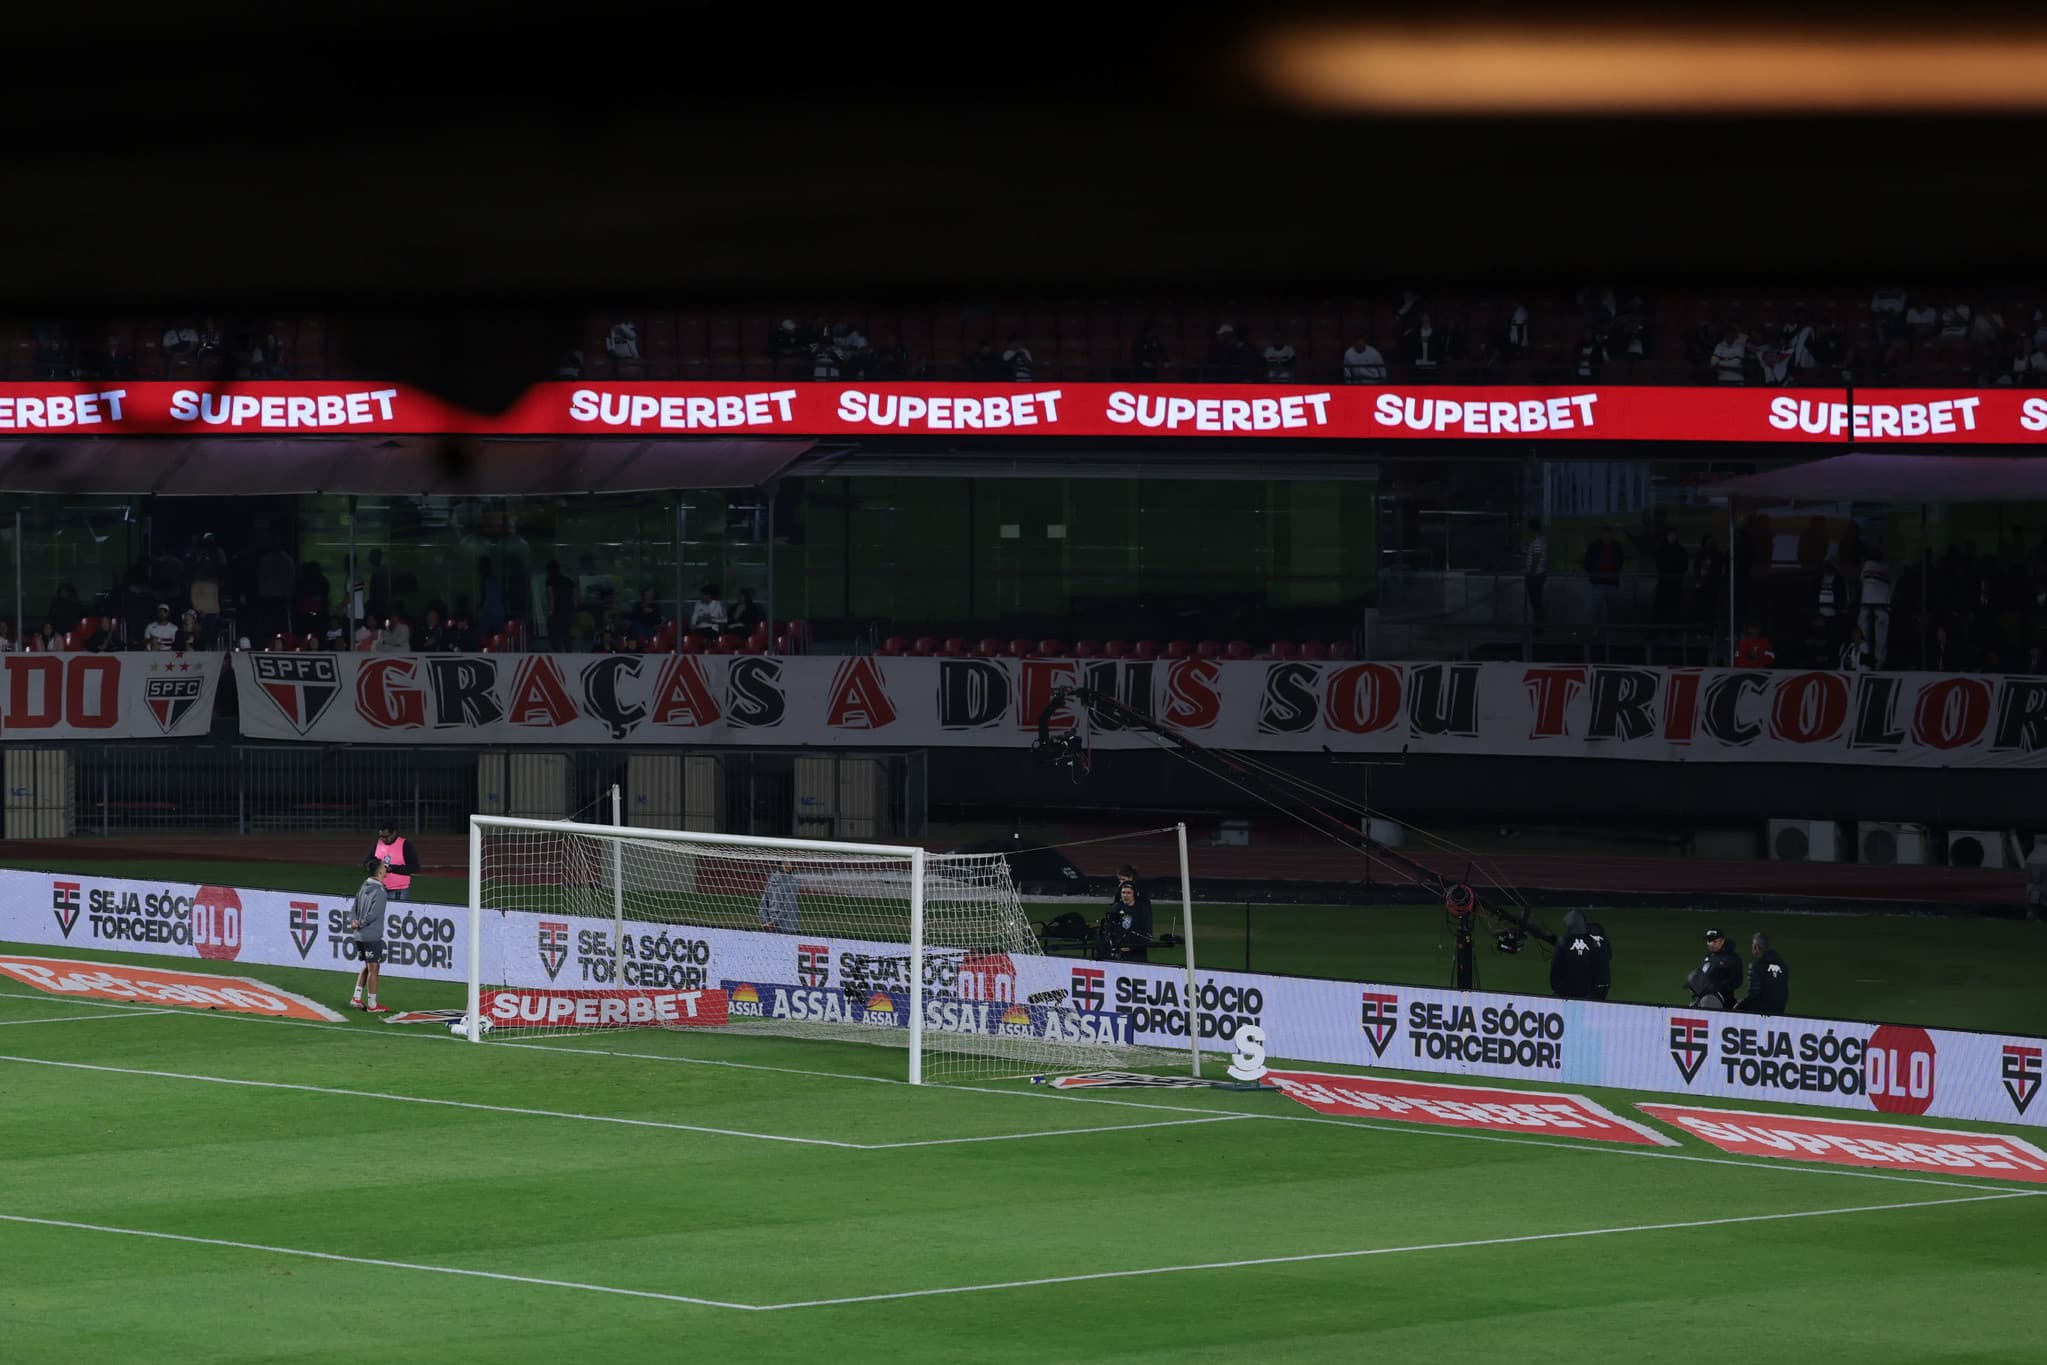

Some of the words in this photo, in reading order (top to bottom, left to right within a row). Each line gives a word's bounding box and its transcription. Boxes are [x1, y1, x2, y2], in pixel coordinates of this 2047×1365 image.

[169, 389, 397, 428] SUPERBET
[570, 389, 797, 428] SUPERBET
[837, 390, 1061, 429] SUPERBET
[1106, 391, 1331, 431] SUPERBET
[1374, 393, 1598, 433] SUPERBET
[1769, 396, 1979, 437] SUPERBET
[150, 681, 199, 696] SPFC
[259, 657, 334, 681] SPFC
[355, 655, 785, 740] GRAÇAS
[826, 656, 897, 730] A
[937, 658, 1222, 735] DEUS
[1258, 661, 1481, 738] SOU
[89, 889, 141, 915] SEJA
[145, 889, 194, 919] SÓCI
[387, 910, 455, 943] SÓCIO
[639, 929, 709, 965] SÓCIO
[491, 991, 702, 1023] SUPERBET
[1116, 977, 1179, 1007] SEJA
[1184, 979, 1263, 1015] SÓCIO
[1409, 1002, 1477, 1033] SEJA
[1481, 1003, 1564, 1040] SÓCIO
[1409, 1031, 1562, 1070] TORCEDOR!
[1721, 1027, 1794, 1059] SEJA
[1800, 1029, 1868, 1066] SÓCI
[1268, 1077, 1612, 1129] SUPERBET
[1676, 1116, 2045, 1170] SUPERBET
